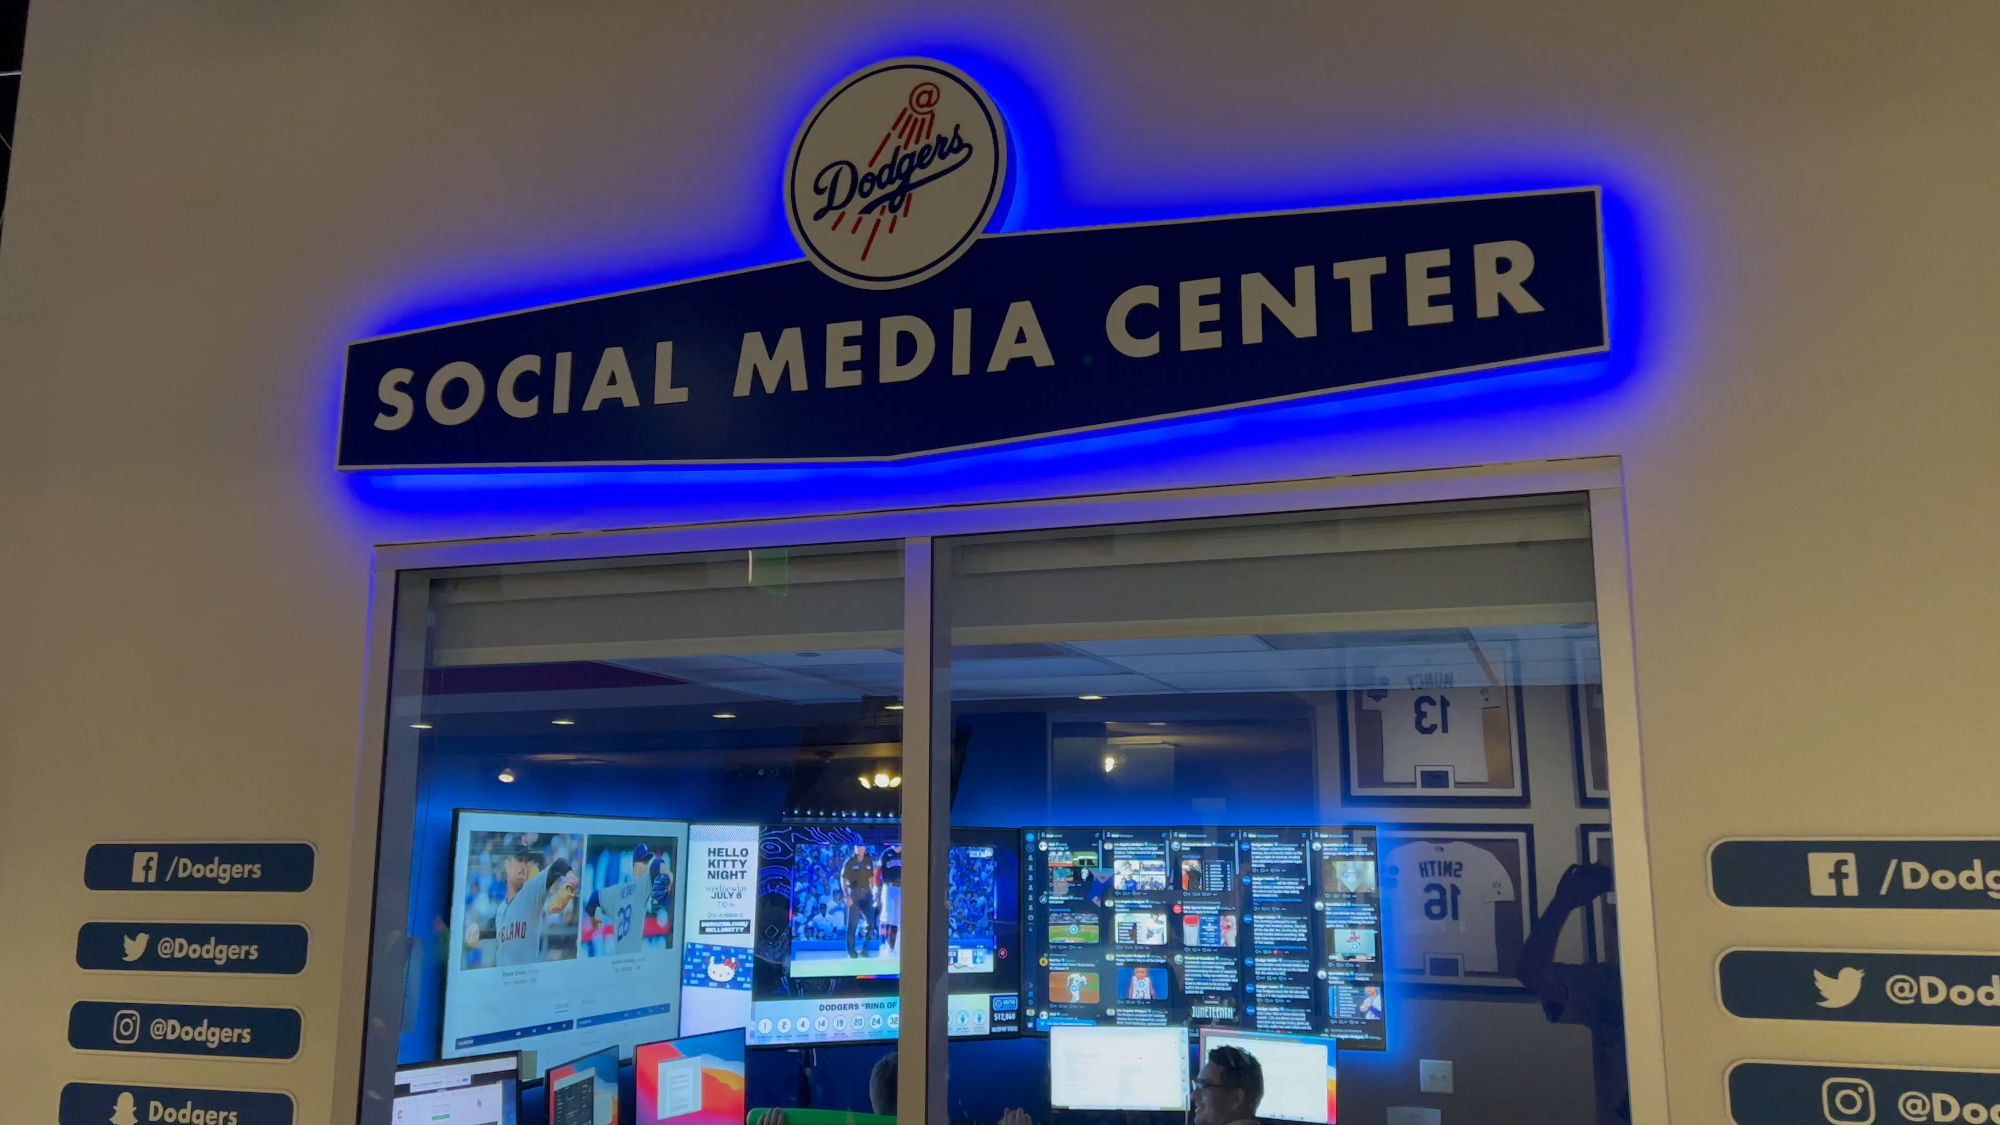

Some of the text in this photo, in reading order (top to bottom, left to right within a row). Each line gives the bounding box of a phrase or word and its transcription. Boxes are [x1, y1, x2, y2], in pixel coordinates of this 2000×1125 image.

[813, 123, 973, 222] Dodgers
[373, 240, 1546, 432] SOCIAL MEDIA CENTER
[707, 847, 749, 858] HELLO
[707, 858, 748, 869] KITTY
[165, 856, 263, 885] /Dodgers
[706, 869, 747, 880] NIGHT
[711, 892, 742, 900] JULY 6
[157, 936, 259, 966] @Dodgers
[819, 1001, 859, 1012] DODGERS
[886, 1001, 897, 1009] OF
[1191, 1005, 1234, 1019] JUNETEENTH
[817, 1019, 826, 1028] 14
[836, 1018, 844, 1027] 19
[853, 1018, 863, 1027] 20
[871, 1017, 881, 1026] 24
[889, 1016, 899, 1025] 32
[150, 1017, 252, 1049] @Dodgers
